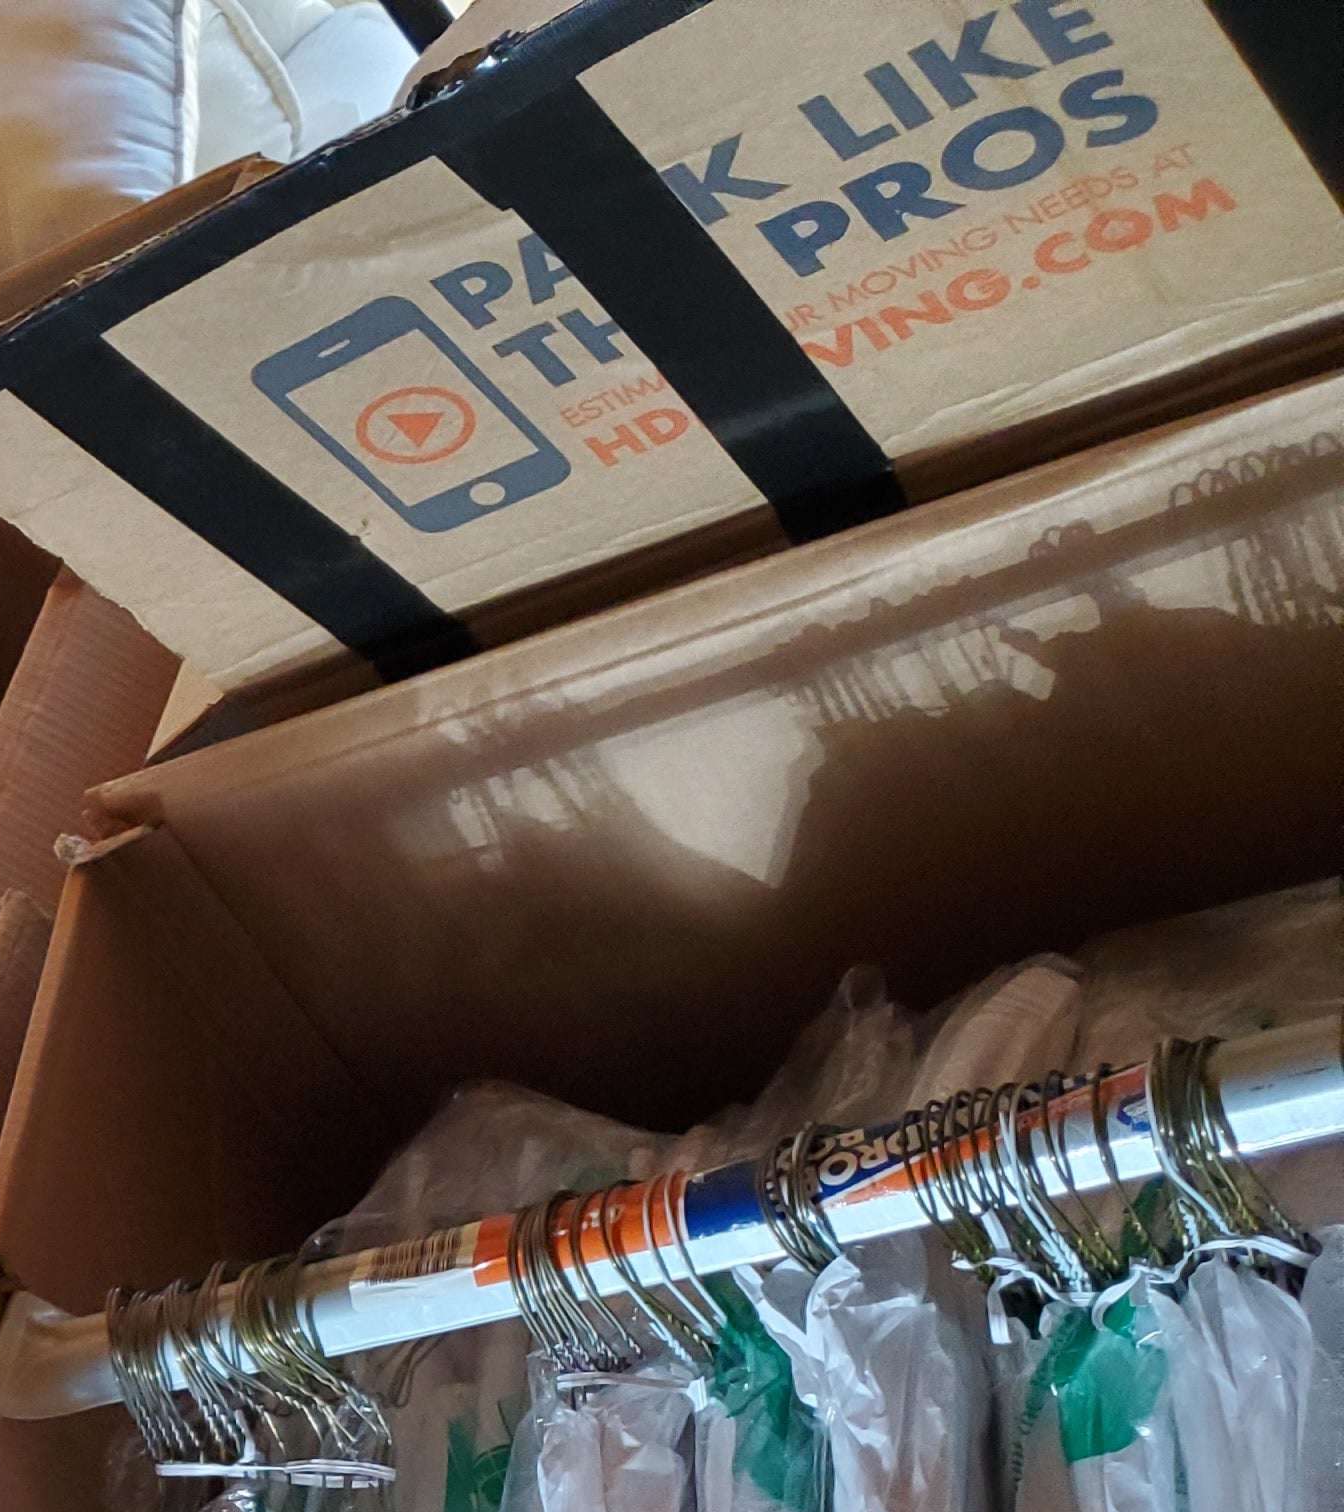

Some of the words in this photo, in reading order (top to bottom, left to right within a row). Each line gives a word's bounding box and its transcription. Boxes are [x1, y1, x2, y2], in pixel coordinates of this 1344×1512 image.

[797, 0, 1115, 162] LIKE
[492, 307, 626, 388] TH
[755, 68, 1159, 278] PROS
[826, 226, 998, 315] MOVING
[1002, 166, 1140, 236] NEEDS
[1152, 141, 1194, 182] AT
